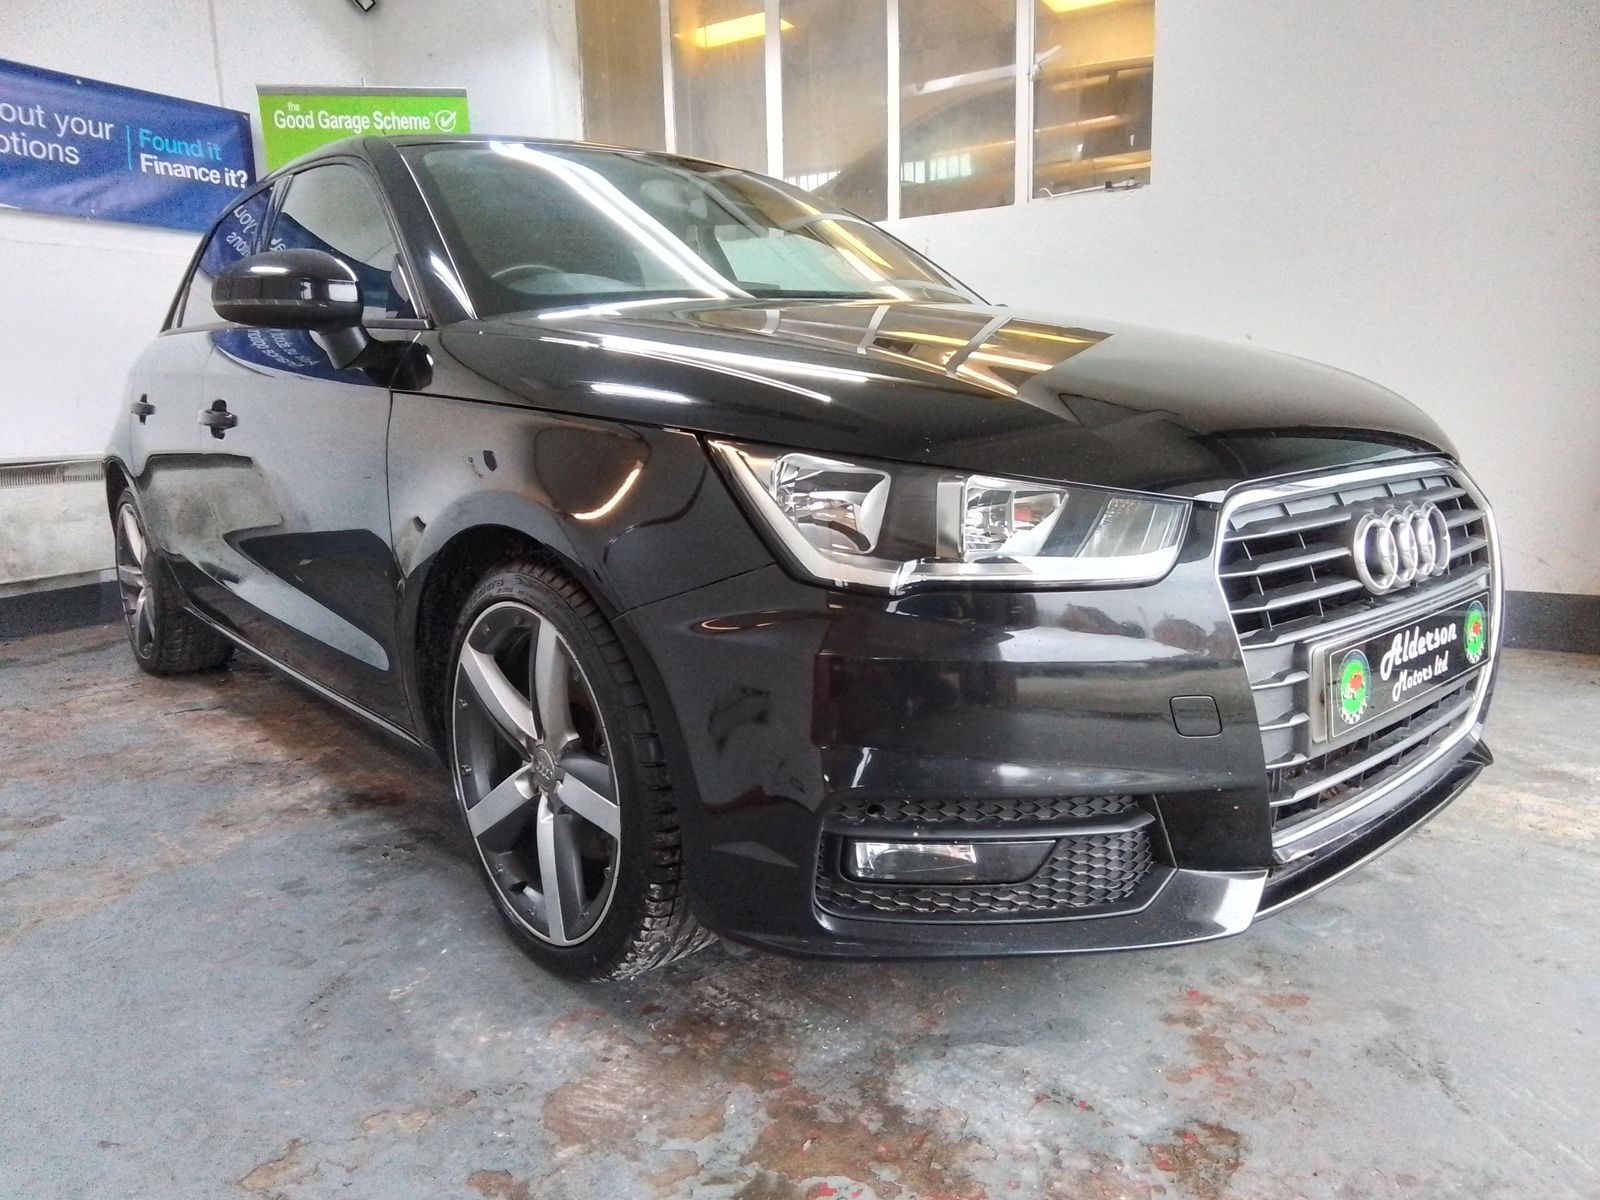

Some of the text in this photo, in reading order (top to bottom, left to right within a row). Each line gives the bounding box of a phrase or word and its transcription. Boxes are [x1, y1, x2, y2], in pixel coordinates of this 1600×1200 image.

[53, 112, 114, 140] your
[274, 109, 431, 134] Good Garage Scheme
[138, 128, 221, 161] Found it
[140, 153, 248, 189] Finance it?
[1380, 622, 1457, 681] Alderson
[1392, 666, 1433, 702] Motors
